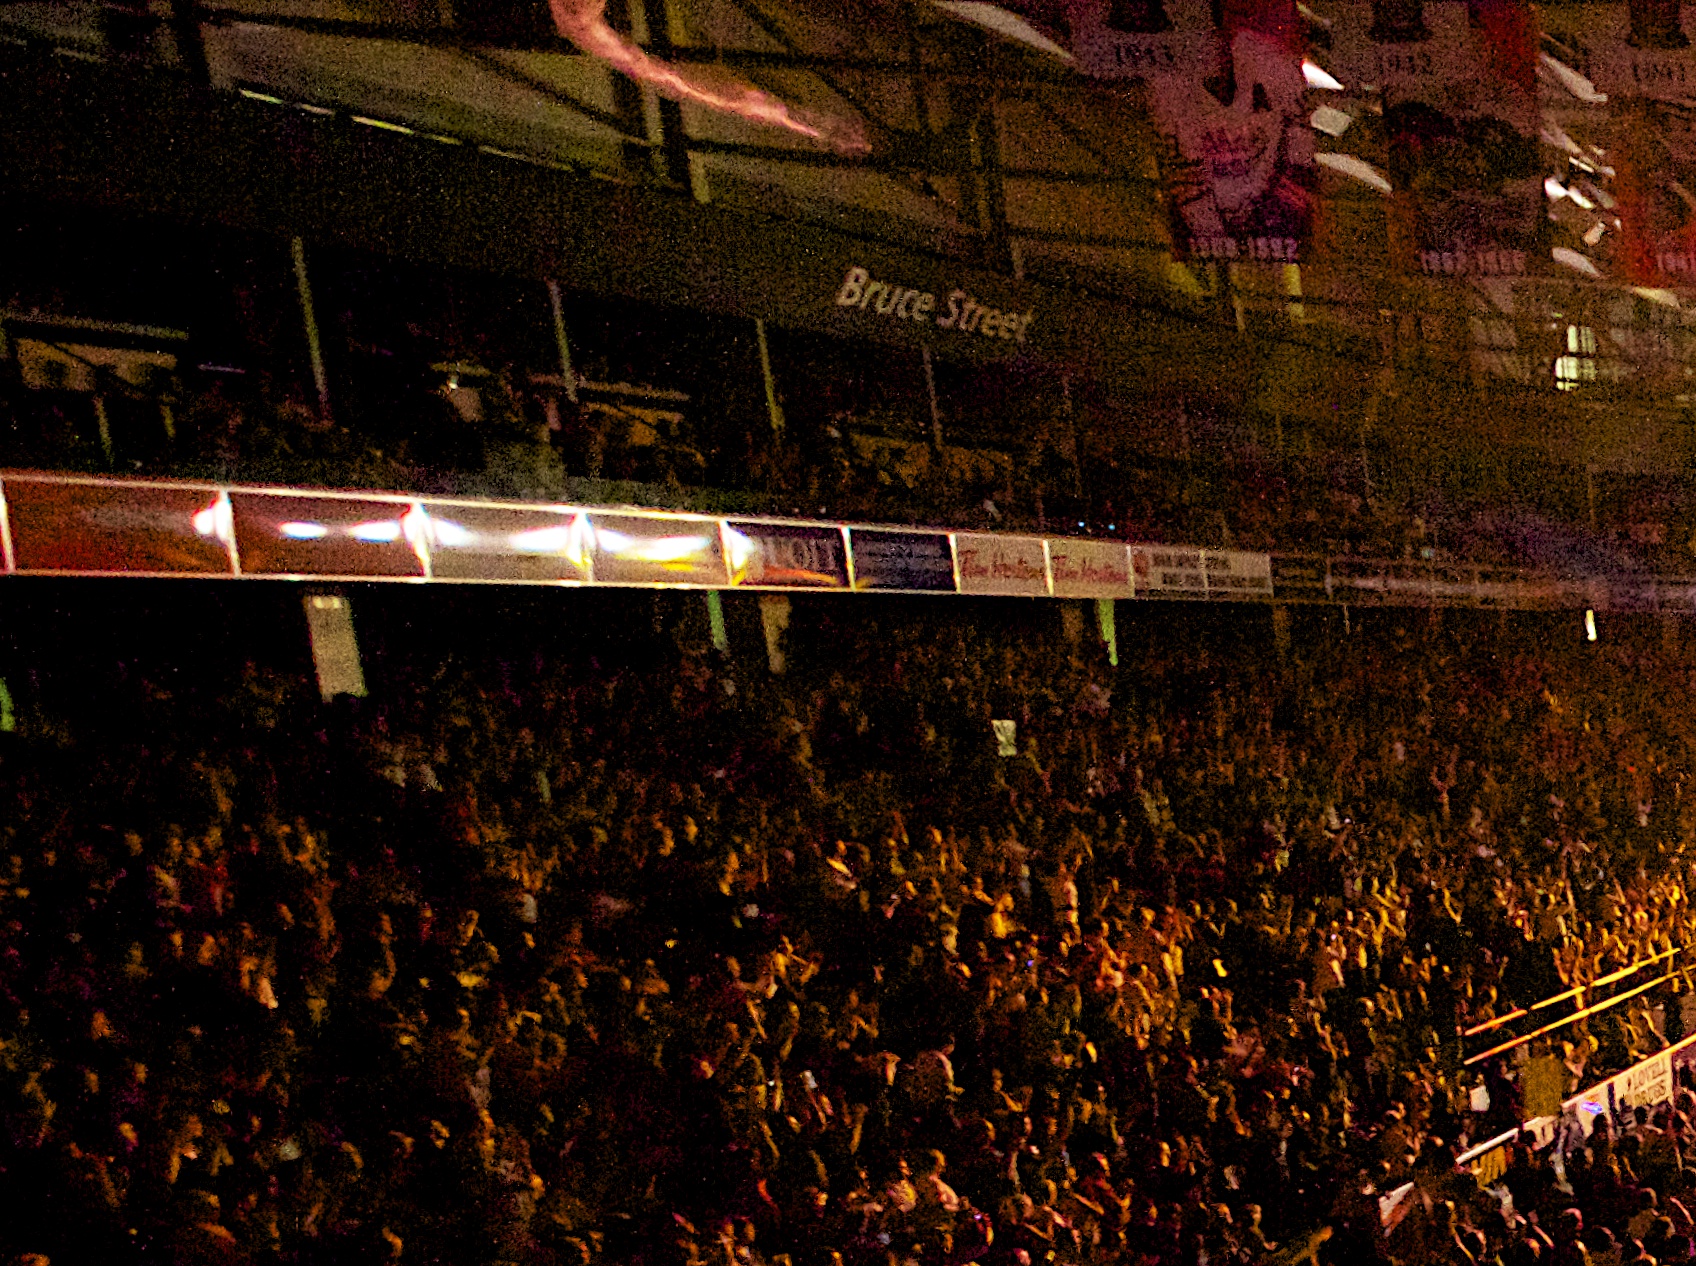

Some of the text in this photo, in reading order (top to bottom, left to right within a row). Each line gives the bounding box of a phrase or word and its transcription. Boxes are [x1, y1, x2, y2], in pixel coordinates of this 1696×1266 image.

[836, 265, 1032, 342] Bruce Street
[1632, 1056, 1669, 1094] LOVELL
